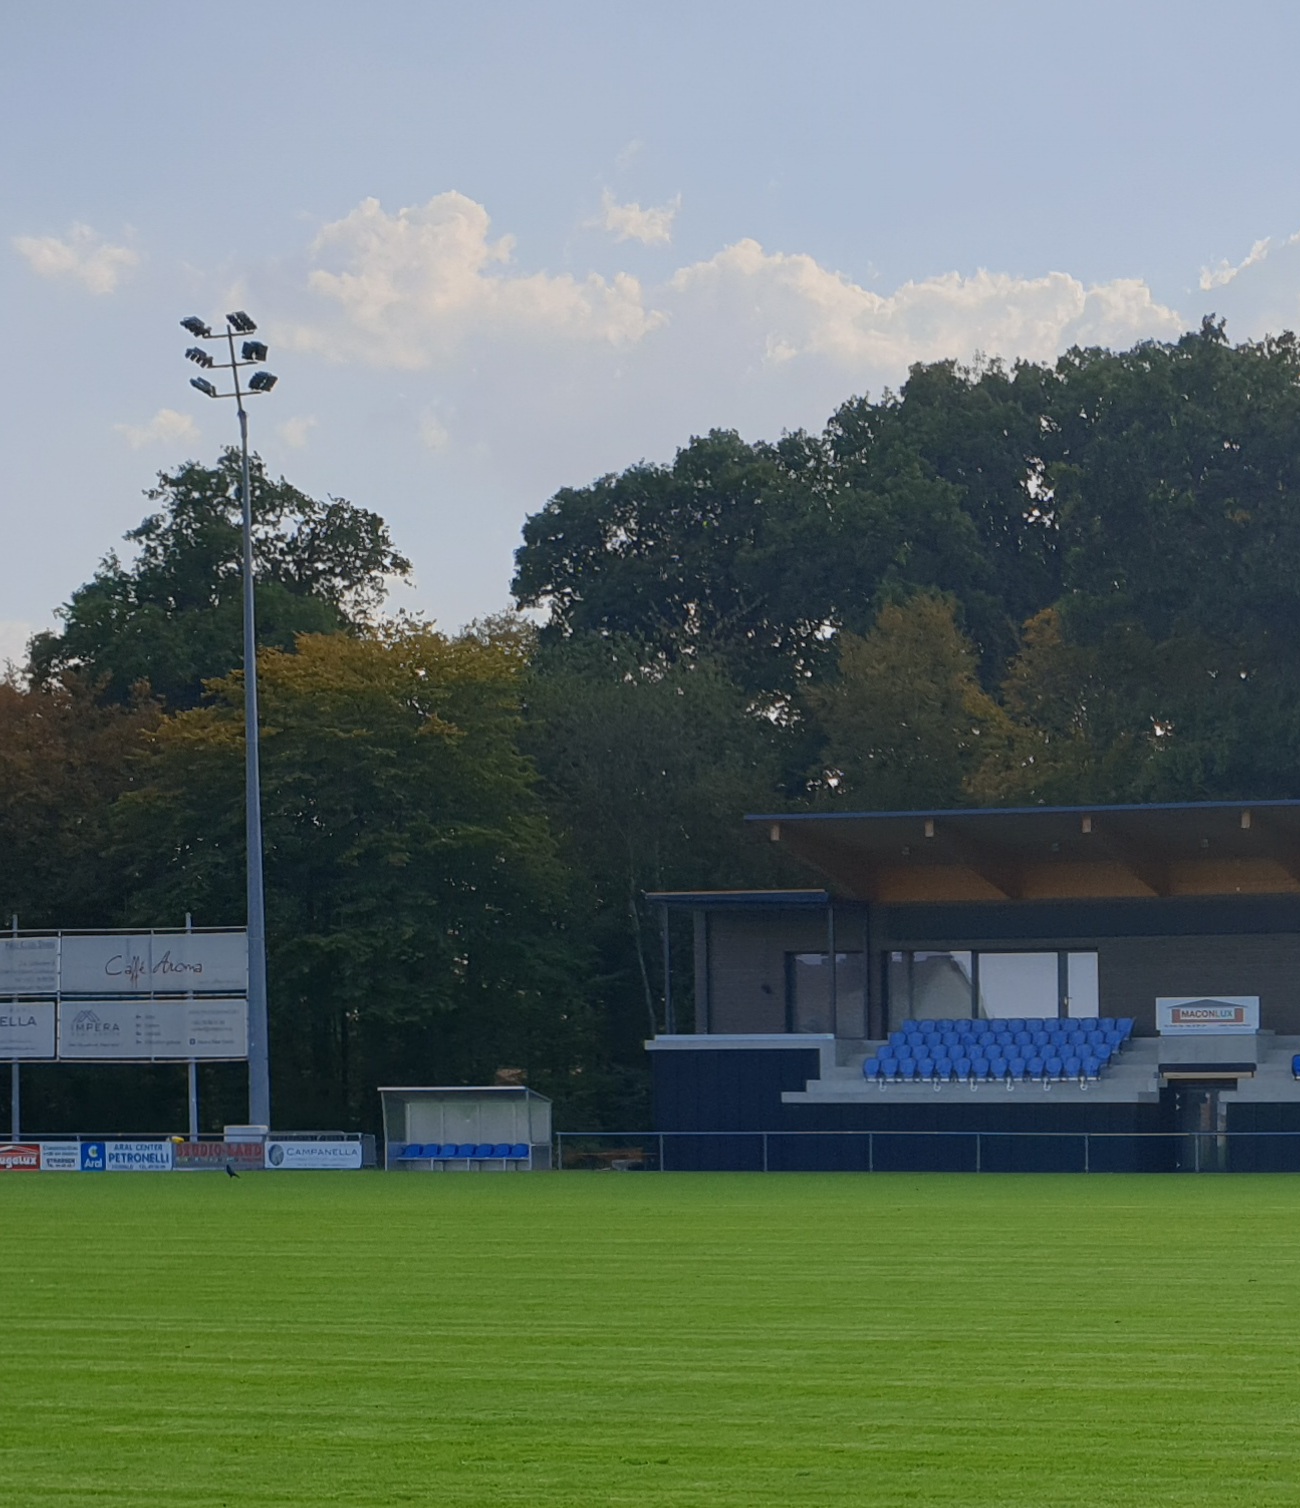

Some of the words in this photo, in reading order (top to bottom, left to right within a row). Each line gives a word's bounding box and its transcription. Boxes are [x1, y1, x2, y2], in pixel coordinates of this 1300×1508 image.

[152, 950, 203, 973] Aroma
[1181, 1009, 1233, 1018] MACONLUX
[286, 1147, 358, 1156] CAMPANELLA
[84, 1158, 103, 1168] Aral
[108, 1153, 169, 1163] PETRONELLI
